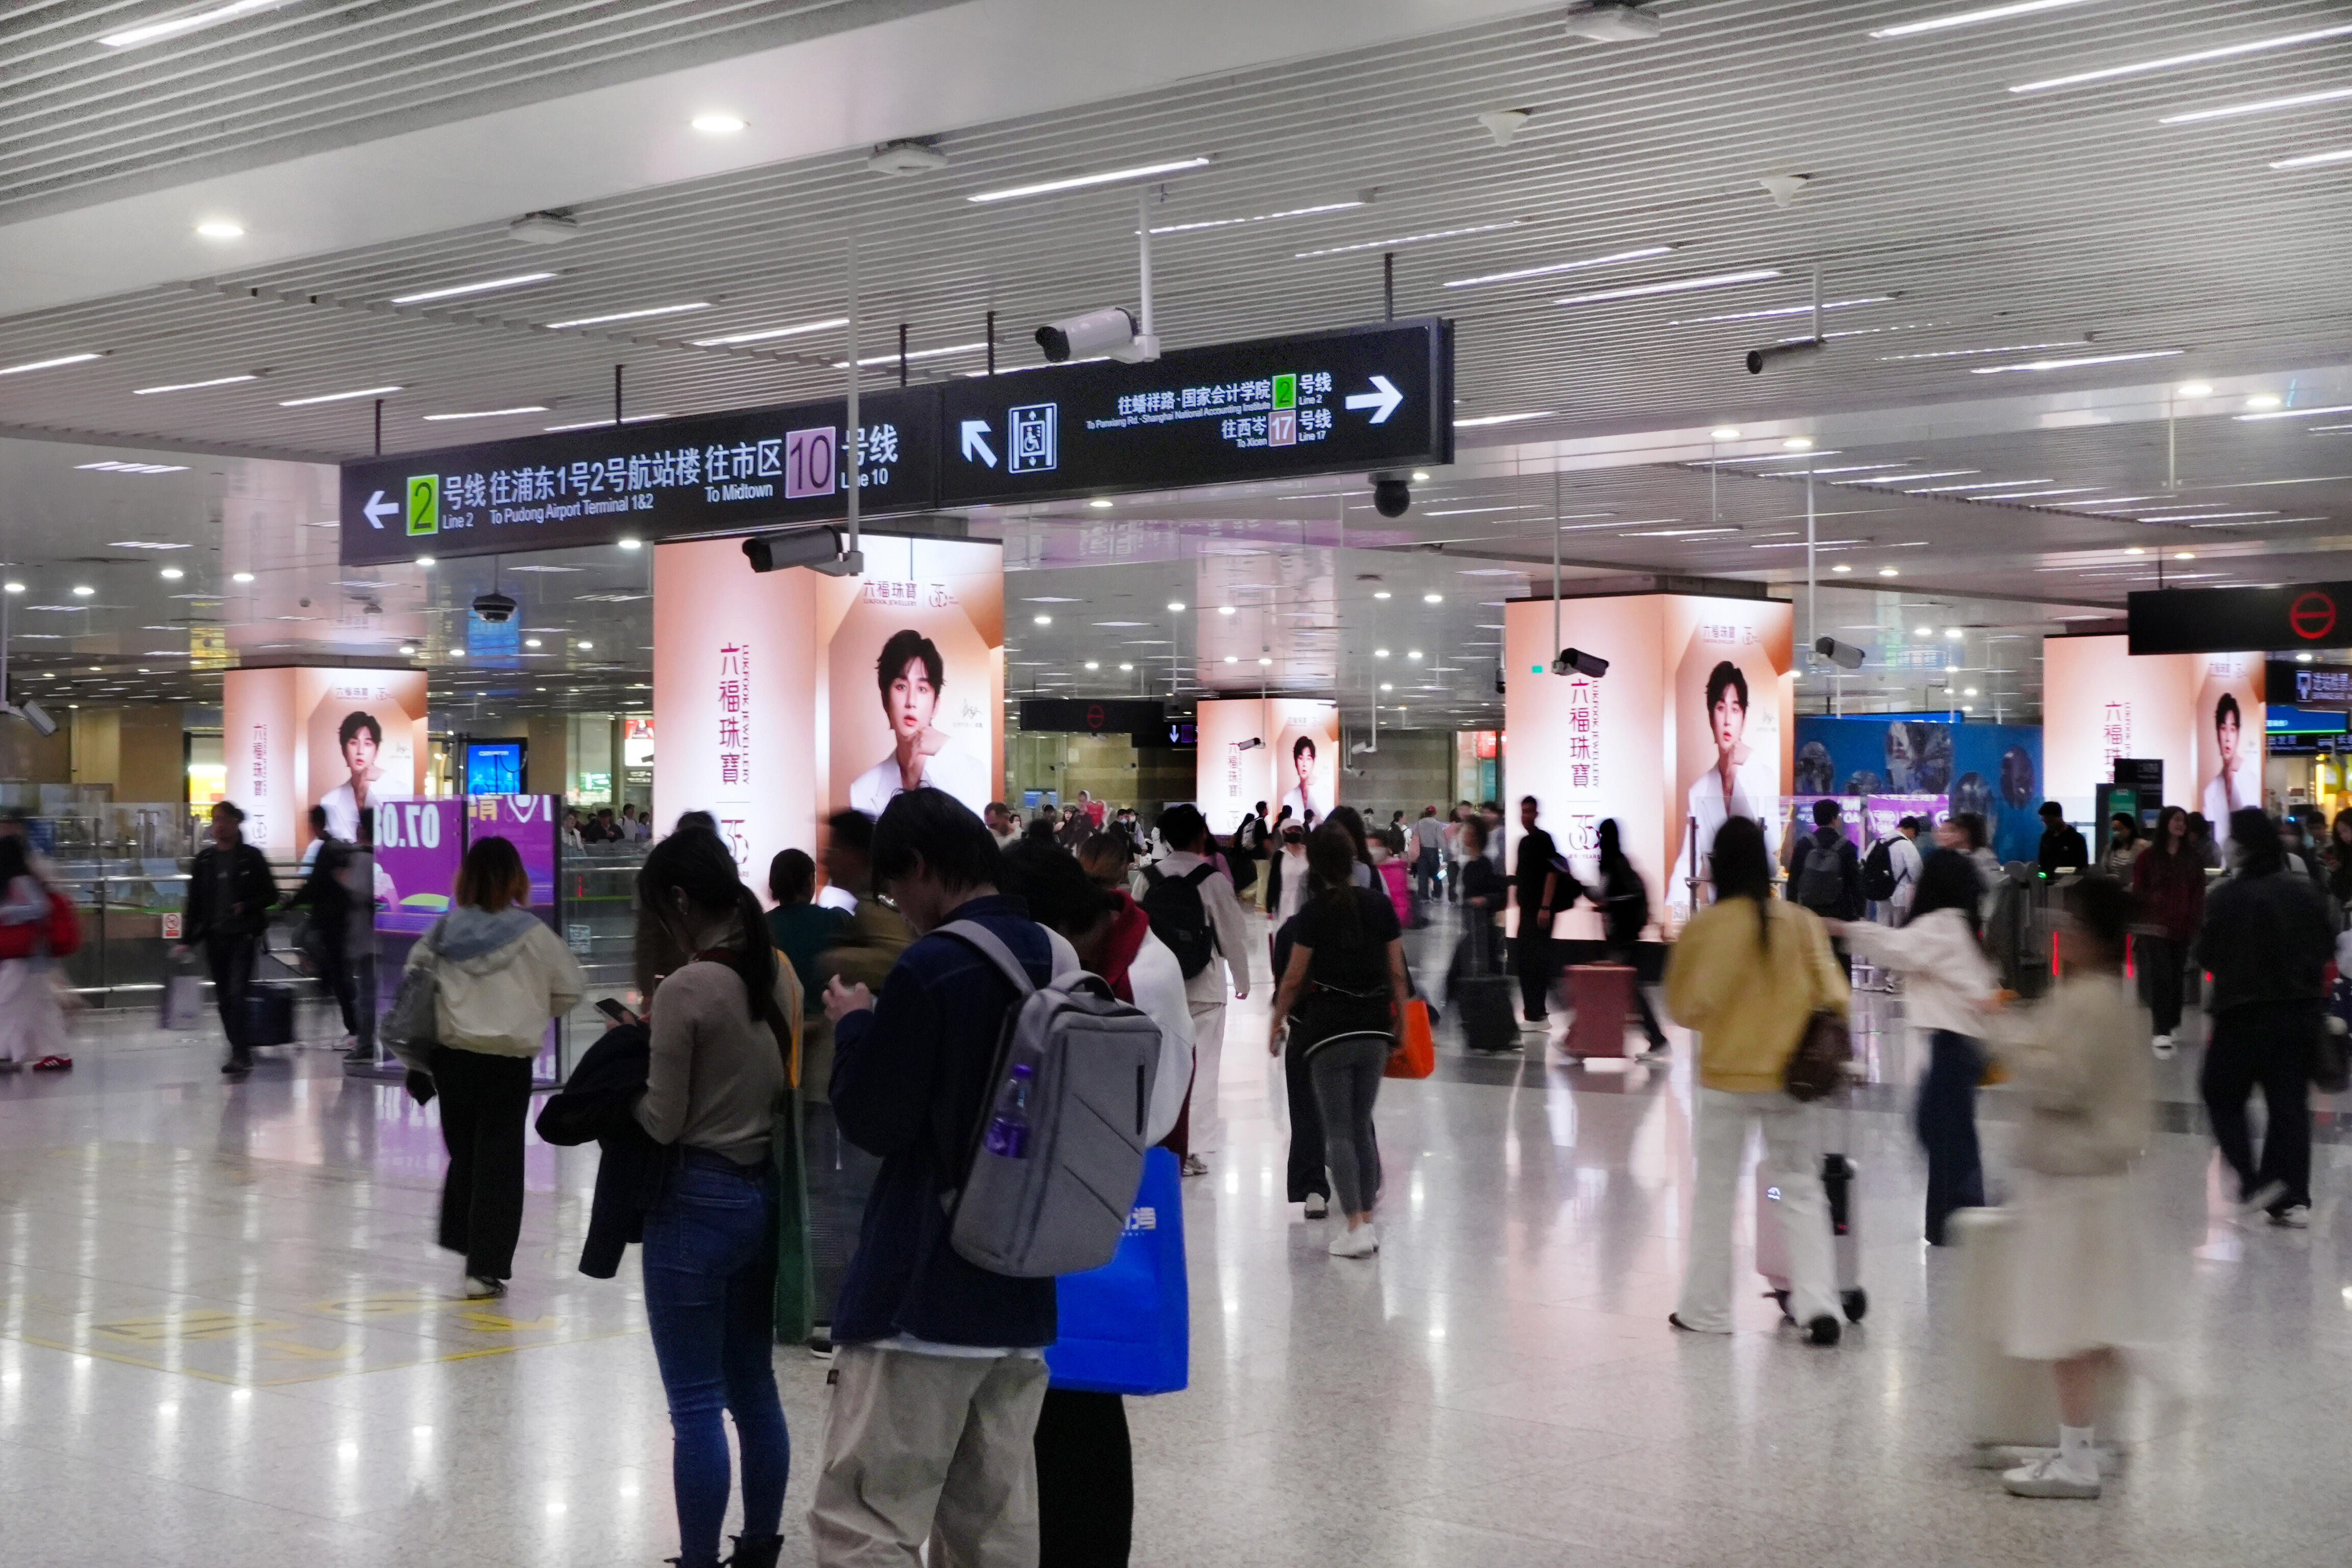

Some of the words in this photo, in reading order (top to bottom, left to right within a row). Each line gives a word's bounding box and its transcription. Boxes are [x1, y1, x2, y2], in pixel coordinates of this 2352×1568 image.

[1174, 408, 1203, 420] National
[1204, 405, 1242, 416] Accounting
[1242, 401, 1271, 411] Institute
[1298, 396, 1315, 405] Line
[1316, 394, 1322, 404] 2
[1280, 381, 1291, 404] 2
[1298, 372, 1332, 394] 号线
[1221, 415, 1267, 440] 往西岑
[1271, 415, 1293, 440] 17
[1298, 408, 1332, 431] 号线
[1236, 438, 1246, 448] To
[1298, 432, 1315, 442] Line
[1317, 430, 1327, 440] 17
[413, 481, 432, 530] 2
[443, 472, 485, 510] 号线
[489, 447, 701, 506] 往浦东1号2号航站楼
[705, 438, 782, 483] 往市区
[790, 435, 831, 490] 10
[842, 423, 898, 466] 号线
[443, 513, 464, 530] Line
[466, 512, 474, 528] 2
[490, 509, 503, 525] To
[504, 505, 544, 526] Pudong
[545, 501, 581, 522] Airport
[584, 496, 629, 516] Terminal
[632, 493, 654, 509] 1&2
[705, 486, 719, 503] To
[722, 482, 773, 502] Midtown
[841, 472, 869, 489] Le
[871, 468, 889, 485] 10
[864, 580, 917, 599] 六福珠寶
[718, 642, 741, 785] 六福珠寶
[1569, 678, 1591, 789] 六福珠寶
[741, 710, 750, 785] JEWELLERY
